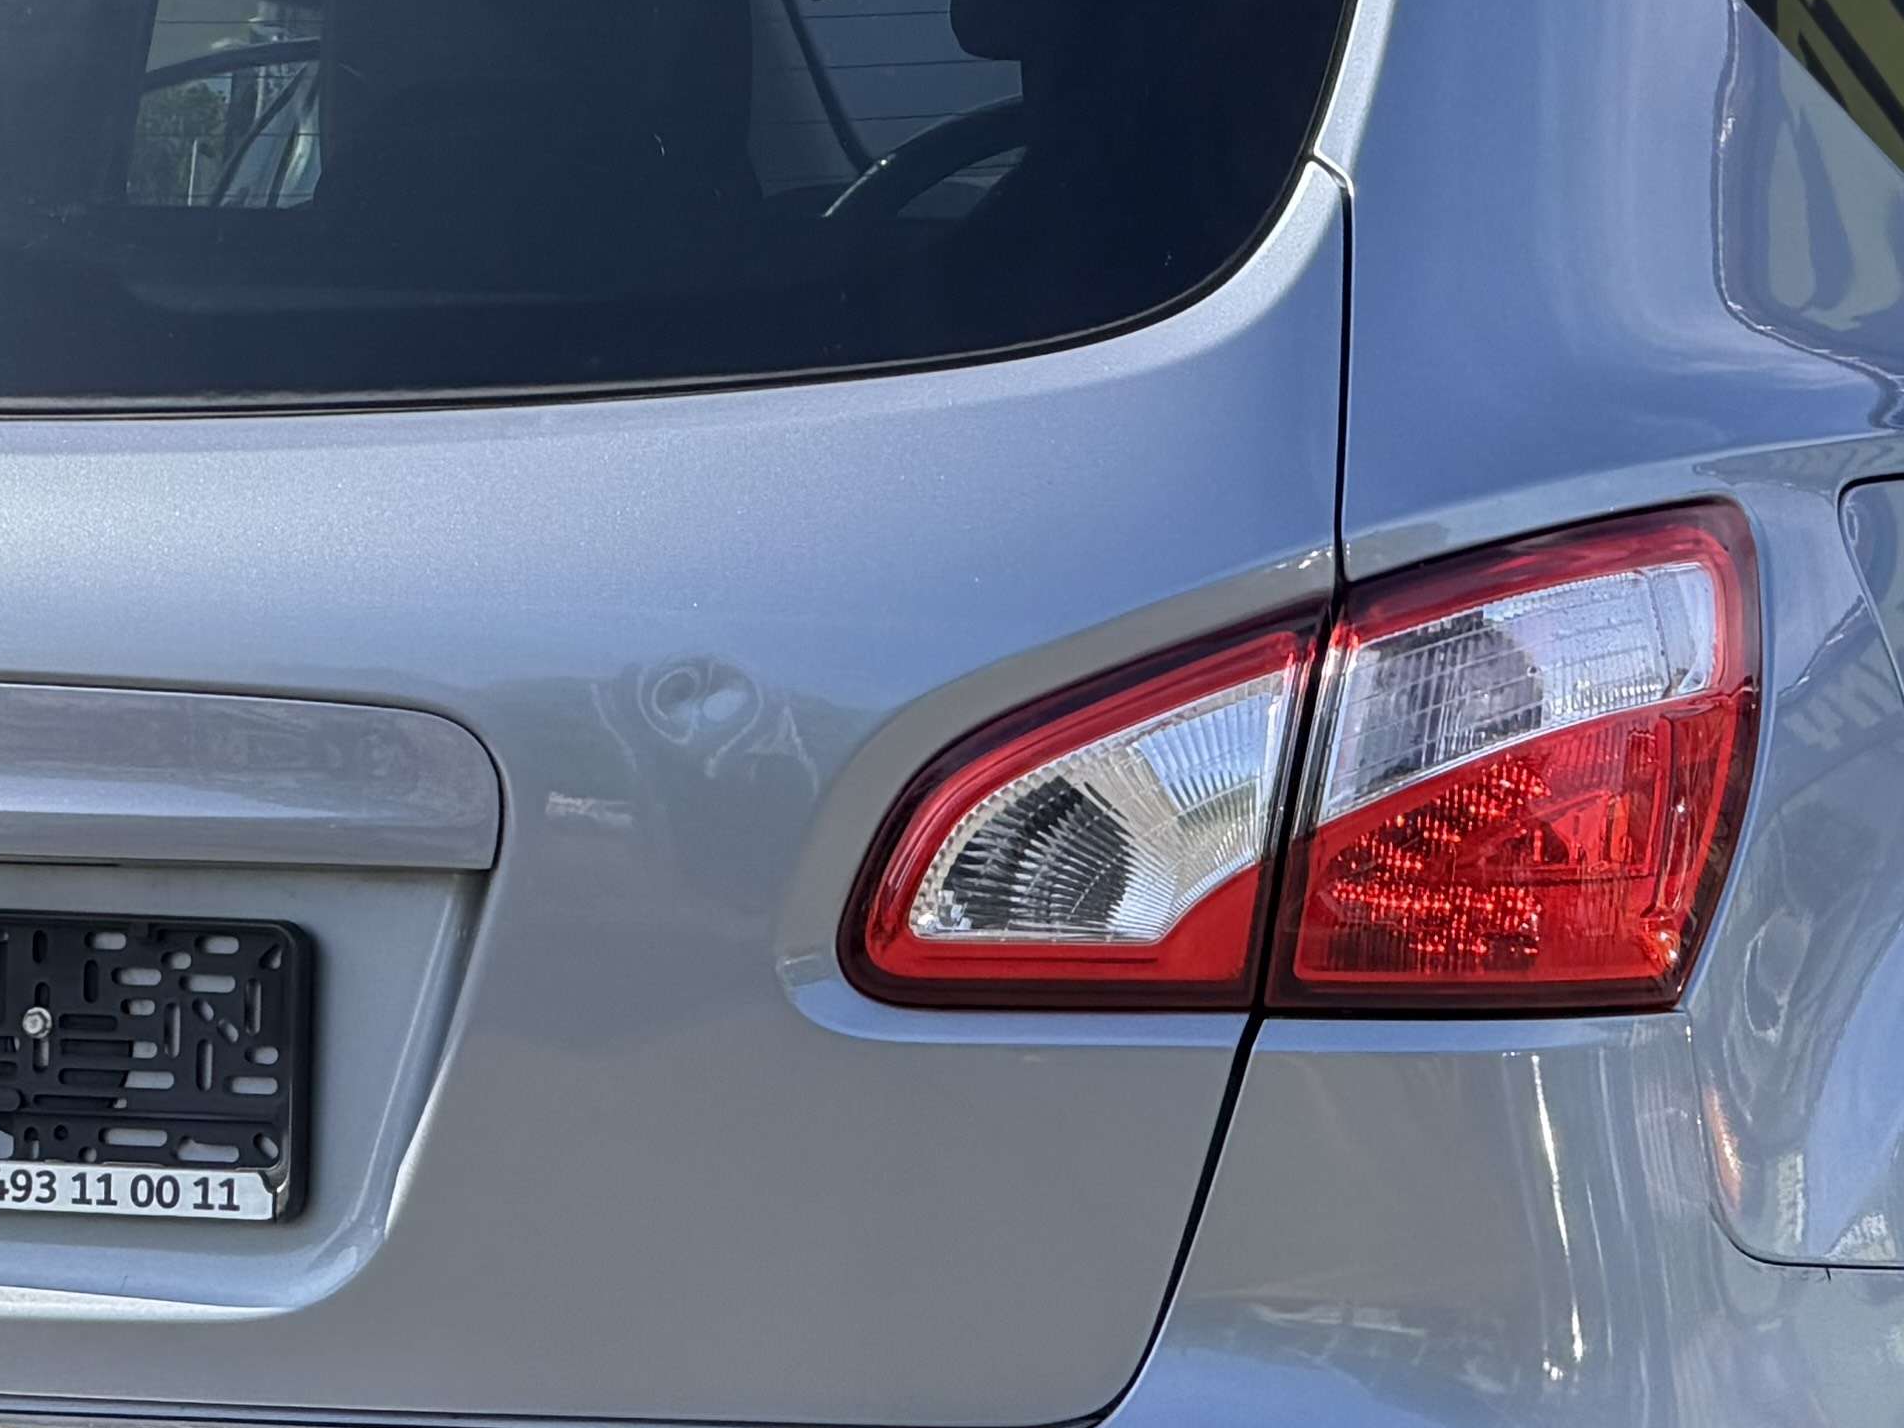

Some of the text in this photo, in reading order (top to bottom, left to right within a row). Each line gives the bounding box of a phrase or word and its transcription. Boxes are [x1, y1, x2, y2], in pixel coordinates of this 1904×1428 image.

[70, 1171, 118, 1208] 11
[129, 1173, 181, 1209] 00
[192, 1176, 241, 1212] 11
